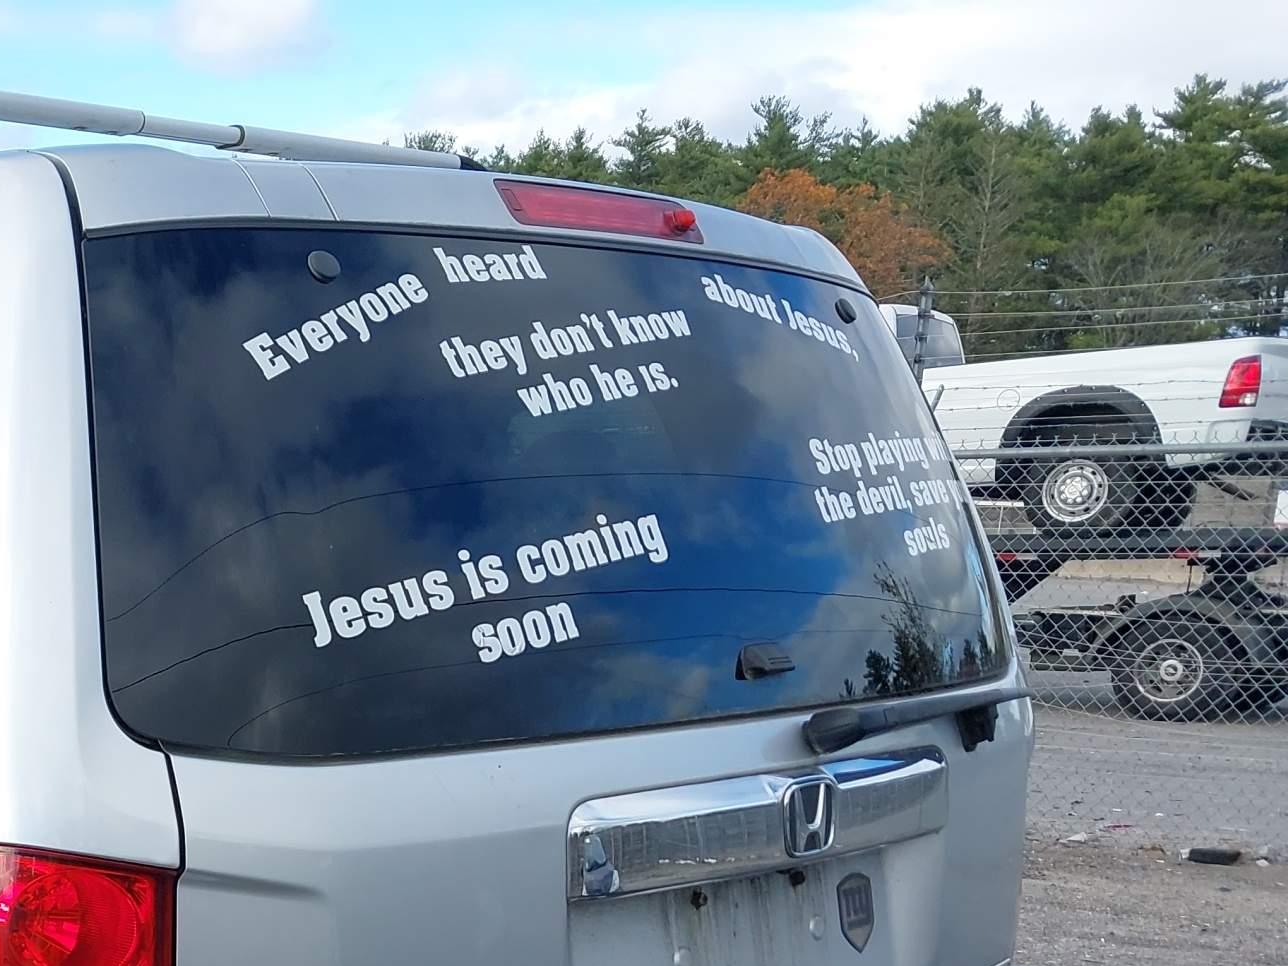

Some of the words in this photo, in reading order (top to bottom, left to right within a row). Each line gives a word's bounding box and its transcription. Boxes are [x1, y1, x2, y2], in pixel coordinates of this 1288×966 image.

[242, 273, 429, 381] Everyone
[432, 244, 547, 283] heard
[701, 274, 783, 325] about
[781, 298, 860, 363] Jesus,
[439, 335, 527, 378] they
[530, 313, 614, 360] don't
[608, 309, 691, 346] know
[516, 373, 593, 417] who
[589, 364, 640, 402] he
[638, 362, 679, 393] is.
[809, 437, 863, 478] Stop
[862, 430, 931, 476] playing
[814, 486, 857, 523] the
[857, 475, 913, 515] devil,
[909, 479, 950, 507] save
[903, 516, 951, 557] souls
[302, 570, 455, 648] Jesus
[457, 549, 509, 600] is
[516, 514, 668, 584] coming
[471, 602, 580, 663] soon
